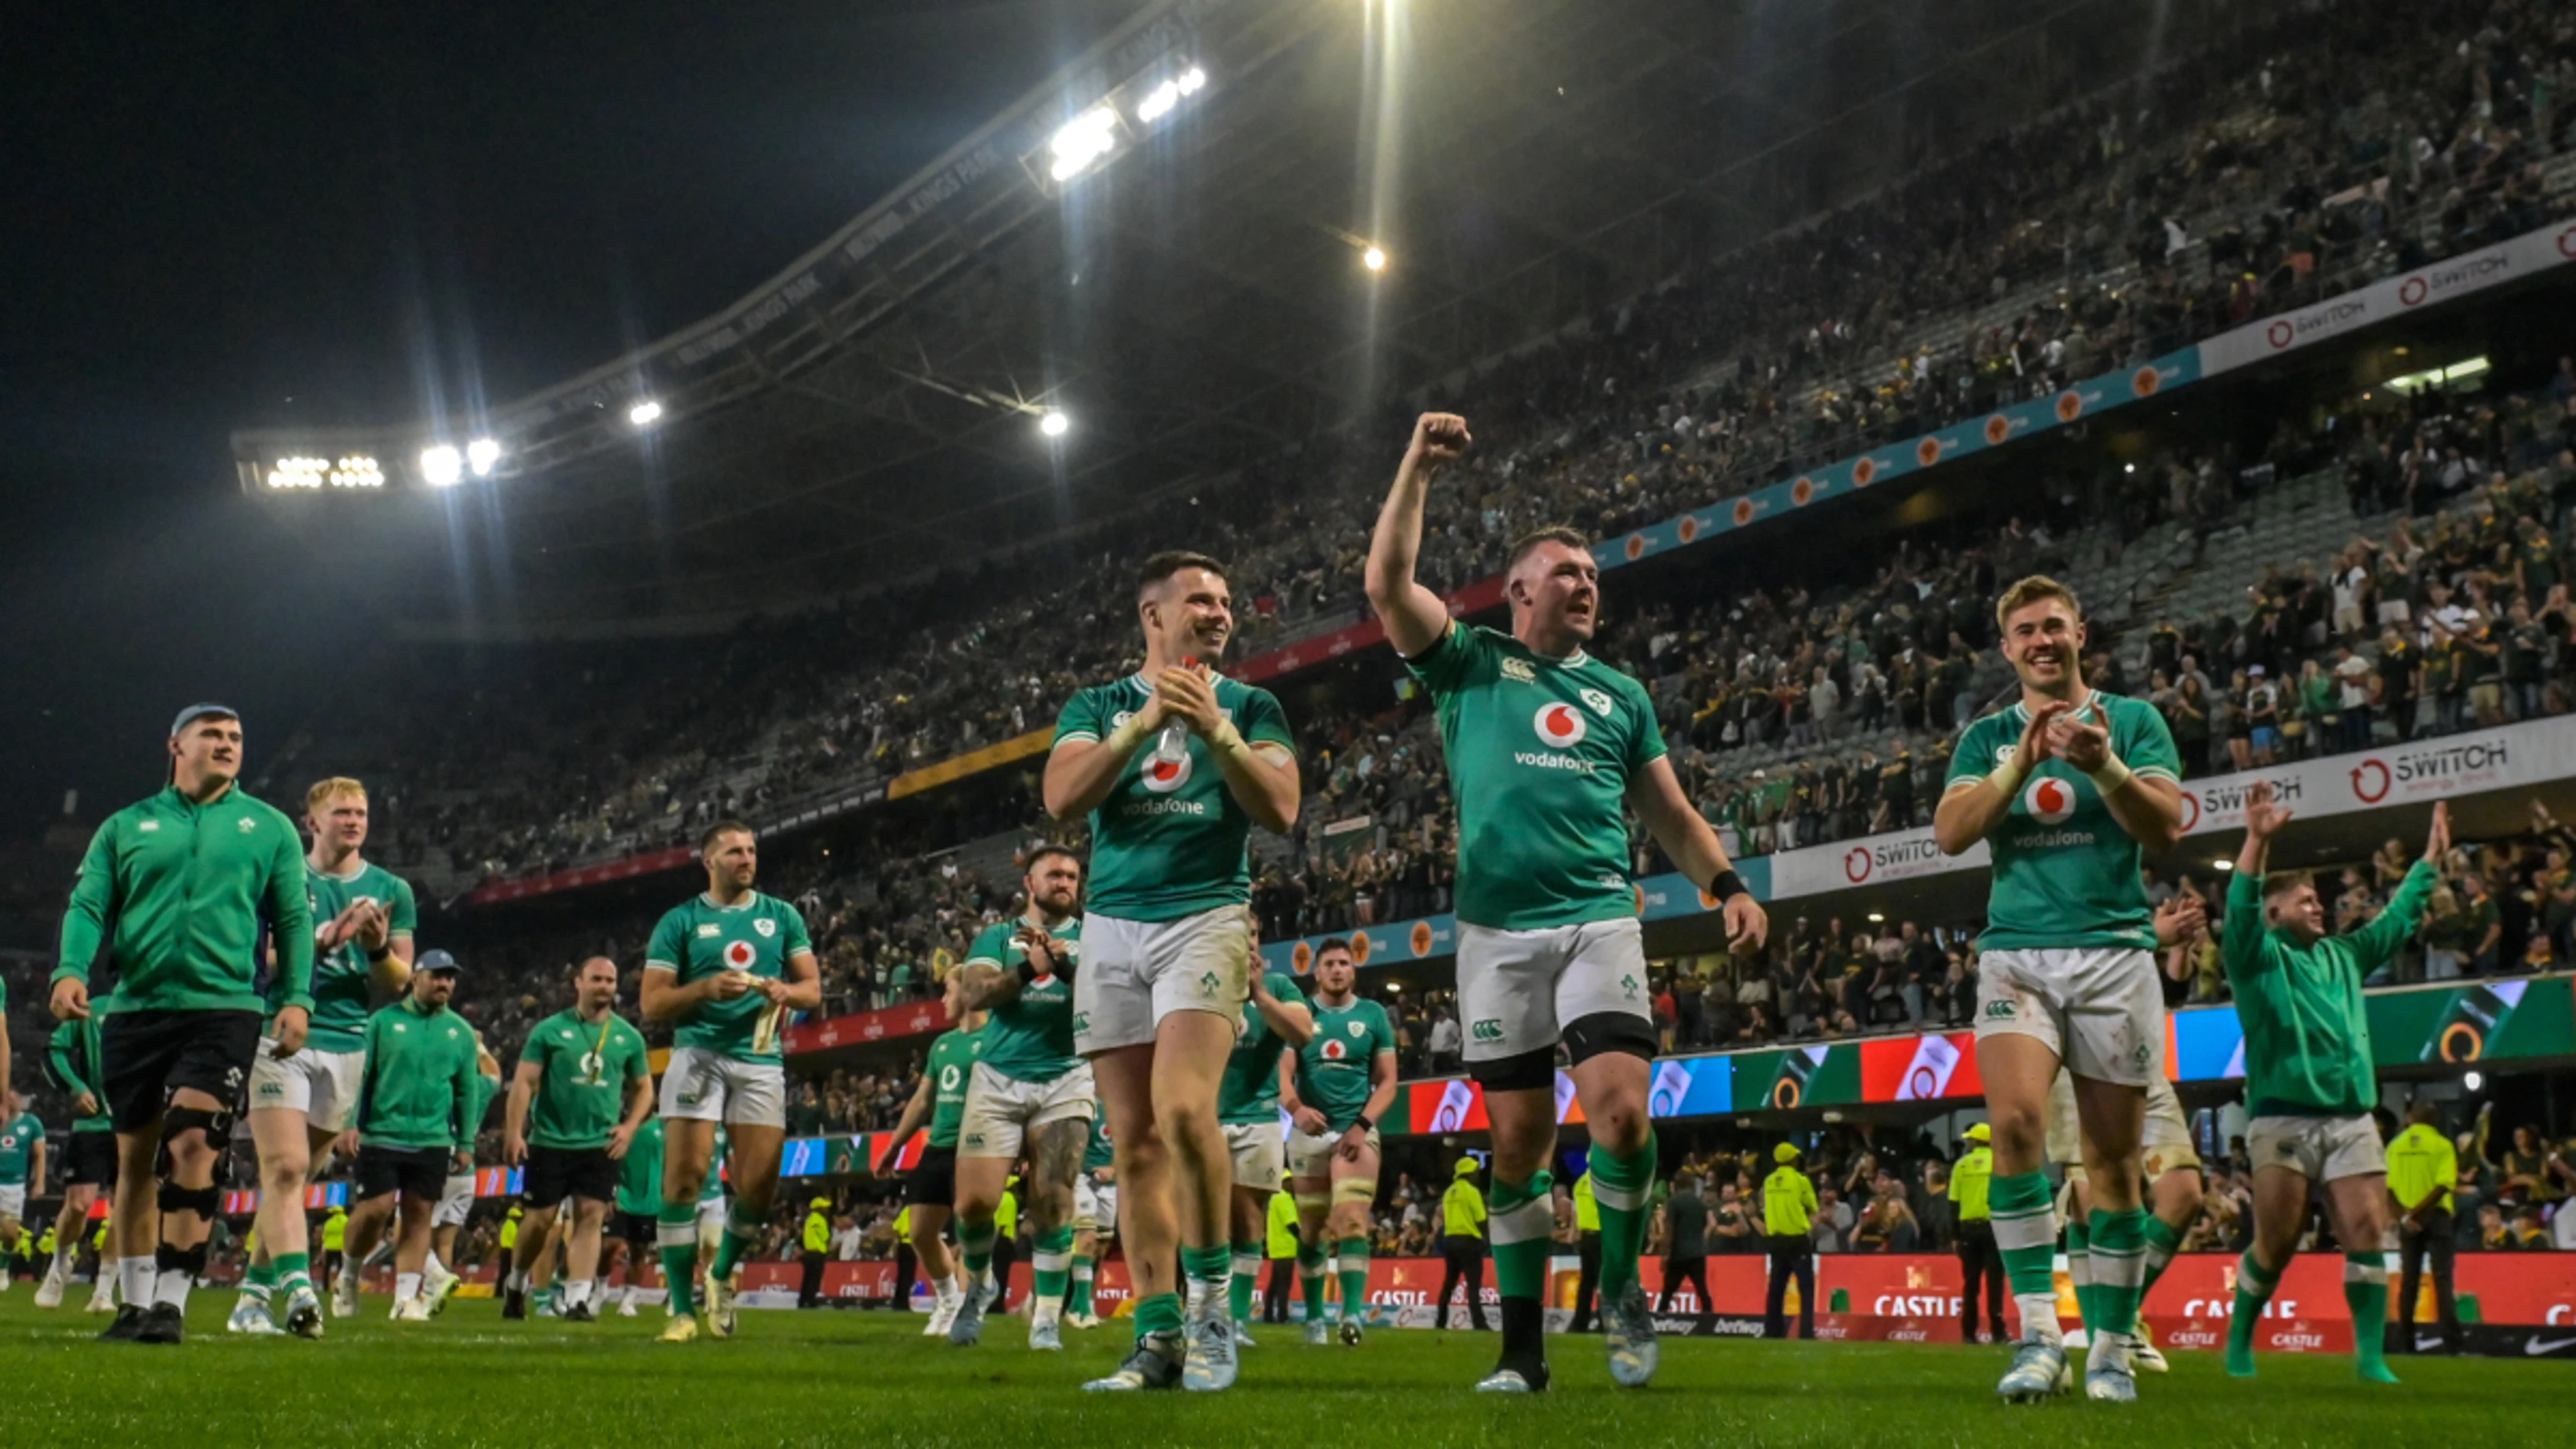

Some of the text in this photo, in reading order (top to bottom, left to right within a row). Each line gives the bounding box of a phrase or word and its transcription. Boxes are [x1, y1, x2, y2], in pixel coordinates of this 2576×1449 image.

[2431, 256, 2508, 290] SWITCH
[2296, 299, 2365, 335] SWITCH
[2396, 739, 2508, 782] SWITCH
[1122, 797, 1205, 816] vodafone
[2013, 829, 2095, 849] vodafone
[1371, 1289, 1428, 1305] CASTLE
[1874, 1295, 1964, 1317] CASTLE
[2169, 1332, 2216, 1345] CASTLE
[2271, 1334, 2324, 1348] CASTLE
